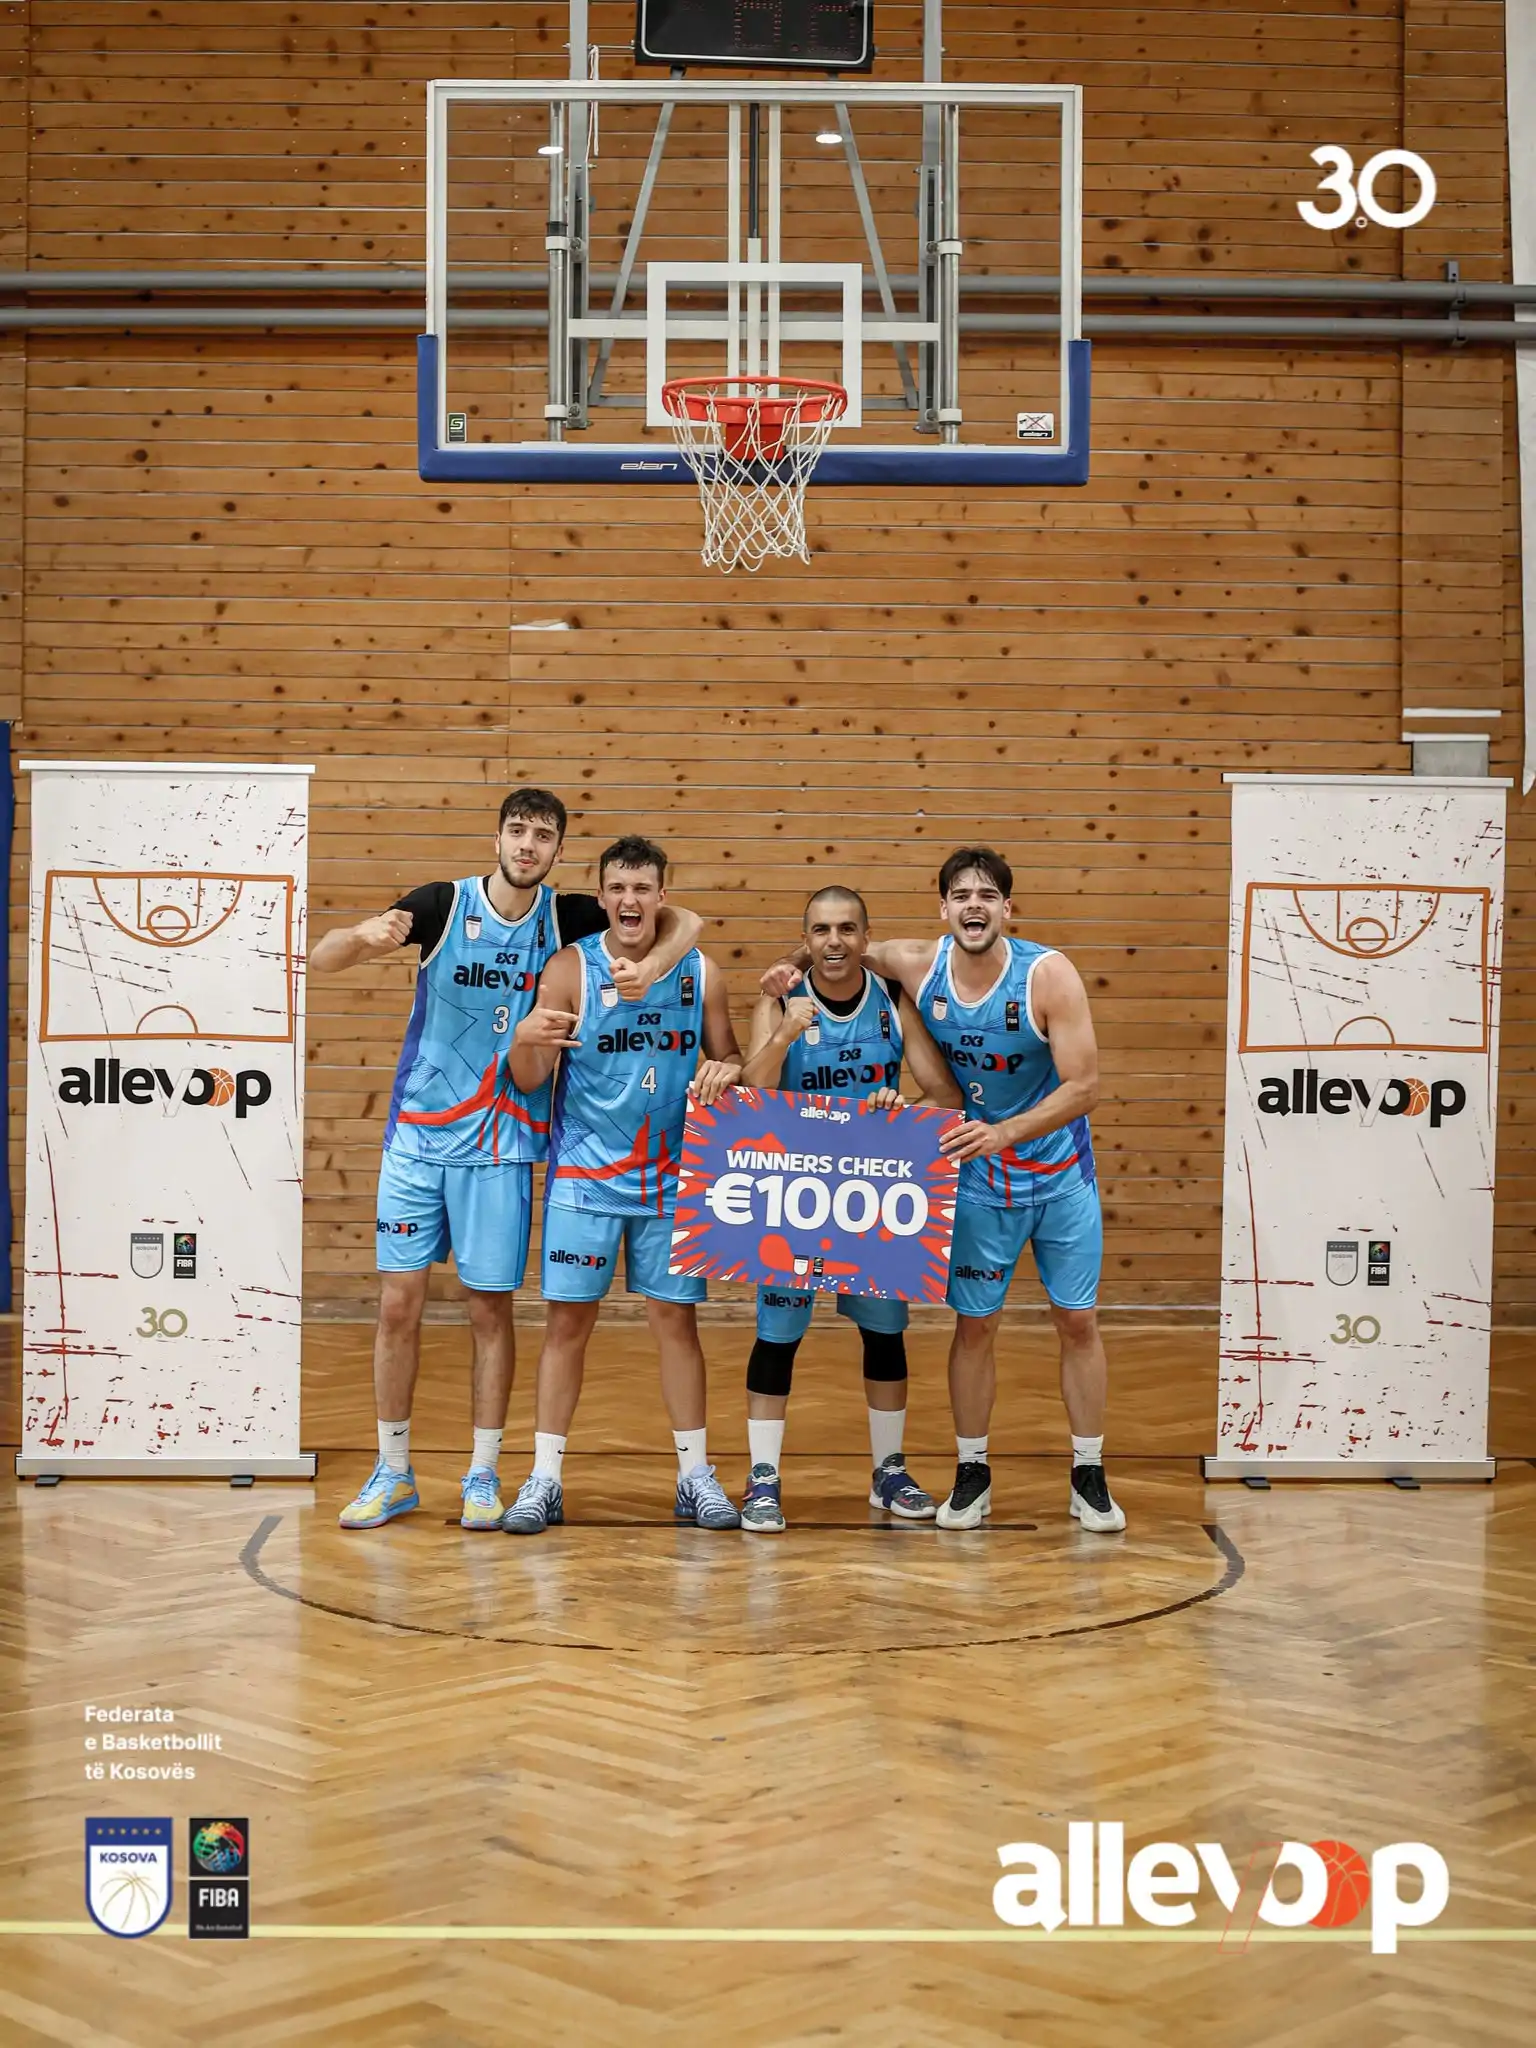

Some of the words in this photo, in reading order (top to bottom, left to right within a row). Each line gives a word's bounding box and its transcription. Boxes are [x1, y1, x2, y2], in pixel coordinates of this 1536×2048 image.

[620, 461, 678, 471] elan
[491, 1004, 510, 1034] 3
[640, 1065, 657, 1096] 4
[968, 1081, 986, 1106] 2
[726, 1149, 833, 1174] WINNERS
[838, 1156, 914, 1178] CHECK
[705, 1172, 929, 1236] €1000
[176, 1259, 193, 1267] FIBA
